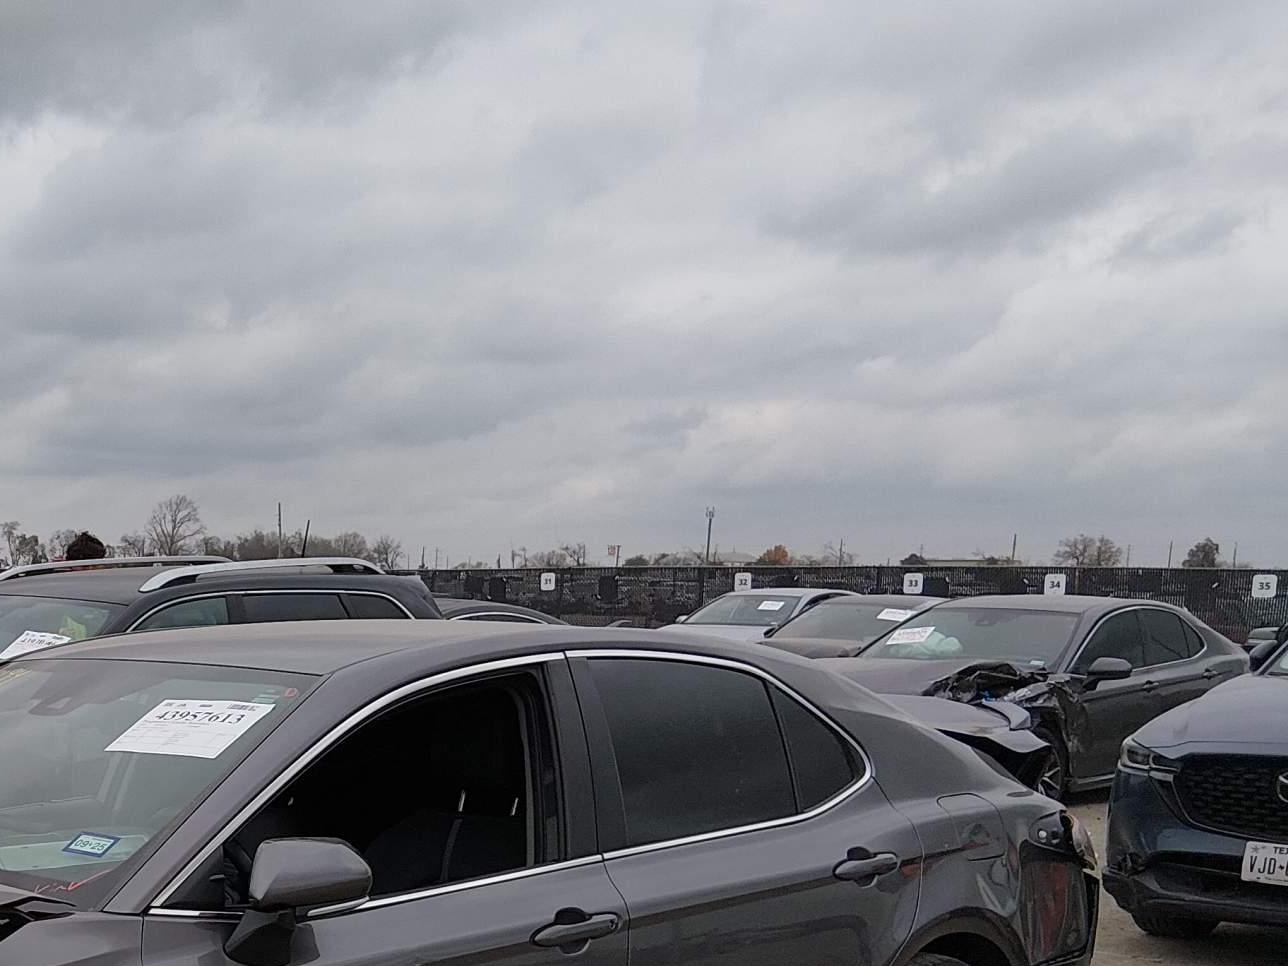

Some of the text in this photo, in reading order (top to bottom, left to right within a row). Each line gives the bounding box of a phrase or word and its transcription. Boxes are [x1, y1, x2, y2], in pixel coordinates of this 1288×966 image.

[1049, 580, 1061, 589] 34
[1258, 581, 1271, 590] 35
[155, 709, 246, 725] 43957613
[1273, 846, 1288, 855] TE
